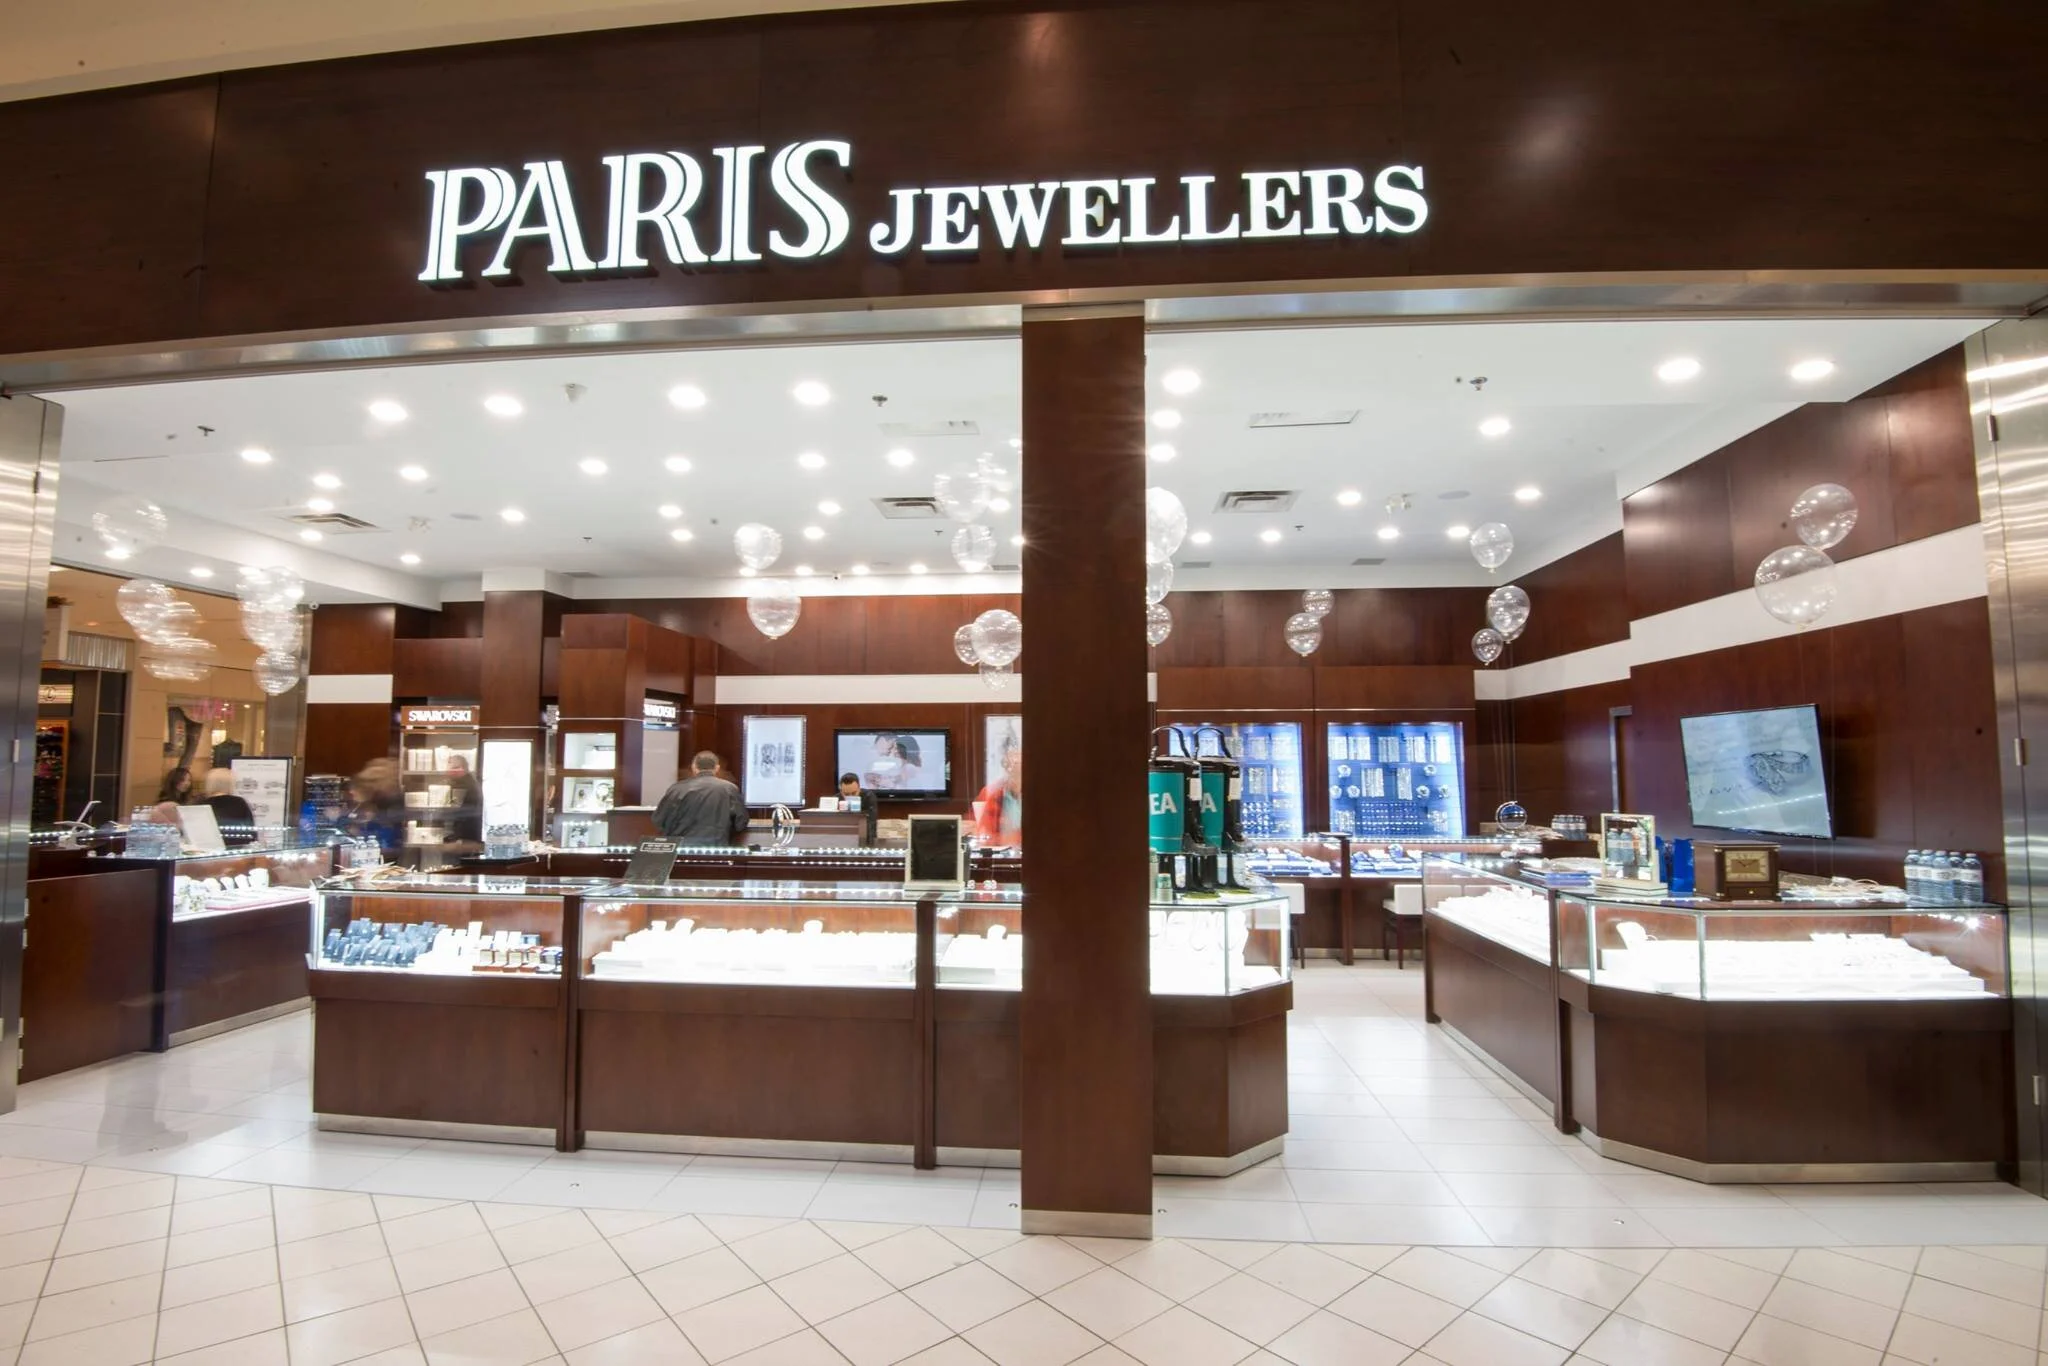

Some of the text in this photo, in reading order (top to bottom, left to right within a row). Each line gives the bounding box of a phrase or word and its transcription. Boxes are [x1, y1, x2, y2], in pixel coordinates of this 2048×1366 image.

[418, 140, 1429, 281] PARIS JEWELLERS
[1149, 792, 1177, 814] EA
